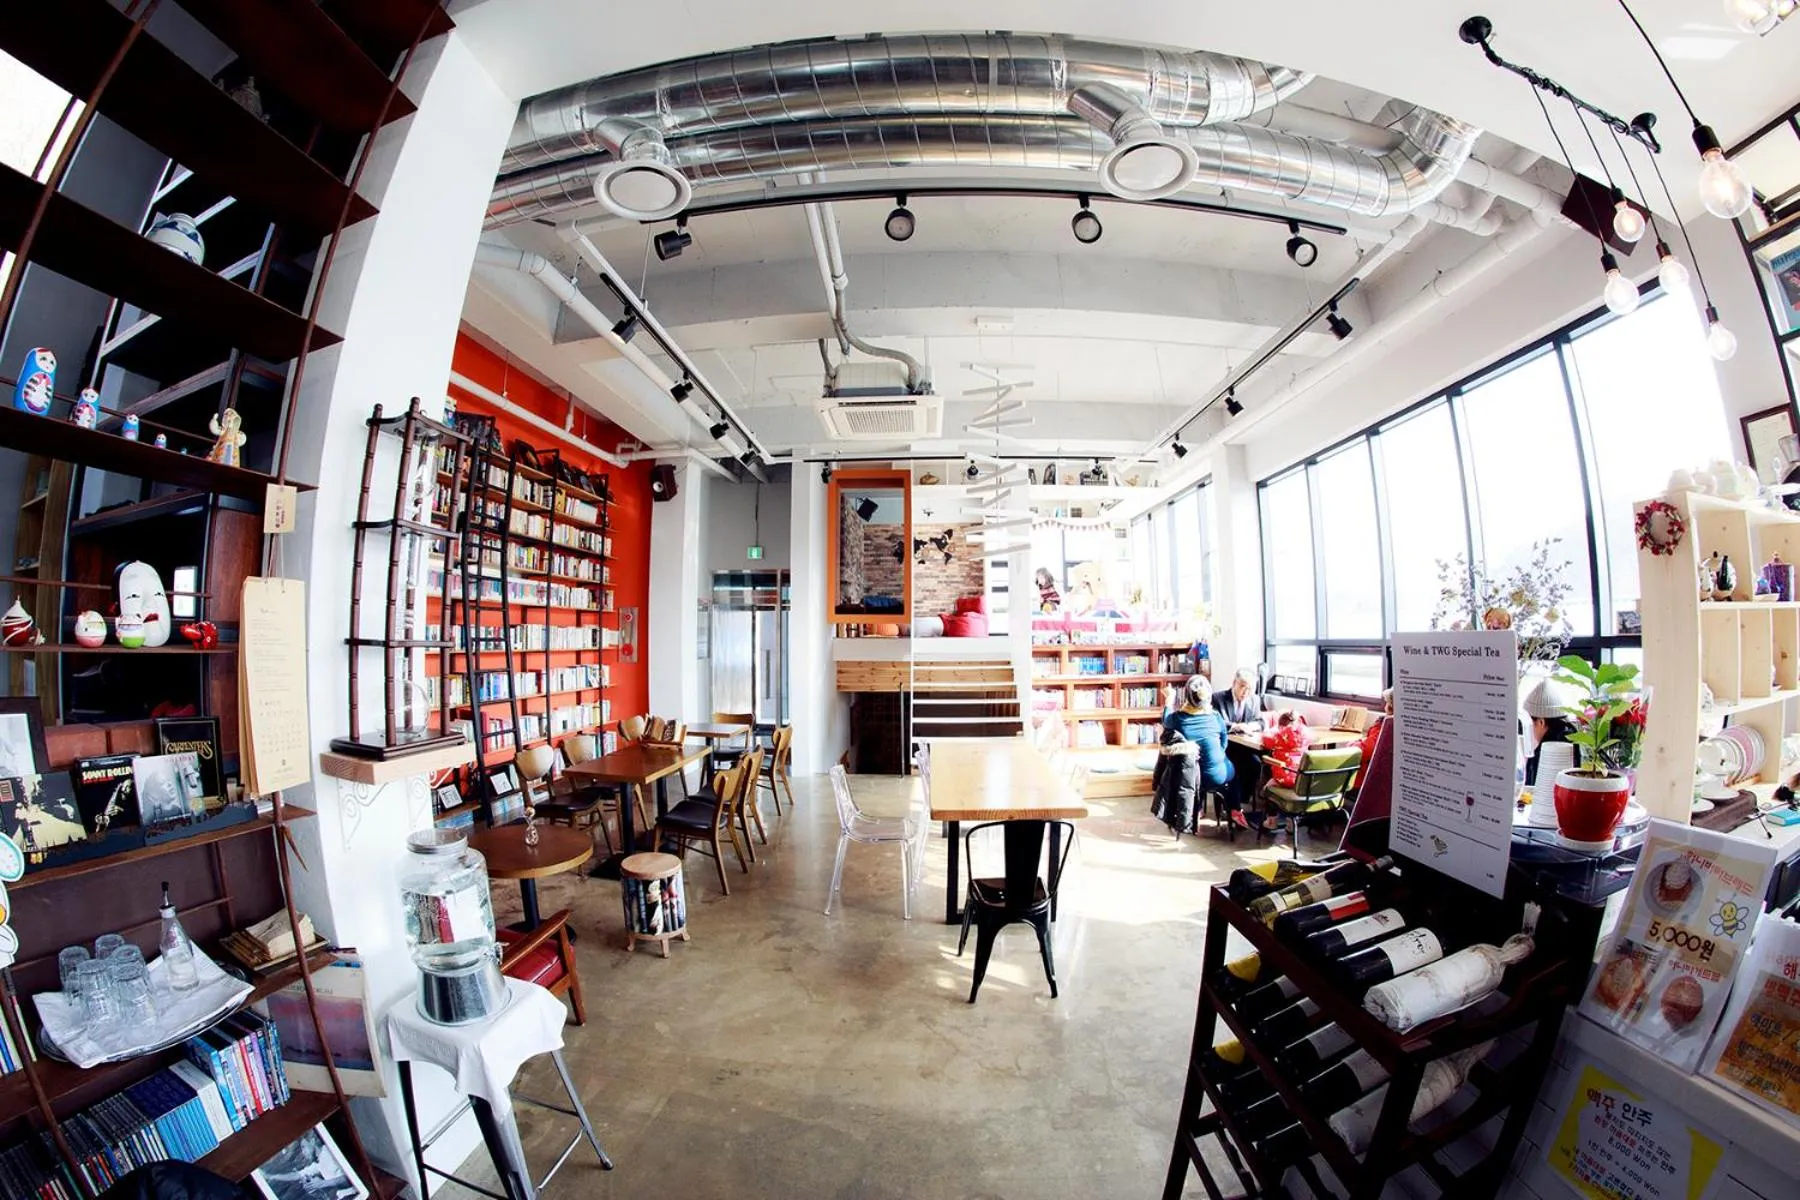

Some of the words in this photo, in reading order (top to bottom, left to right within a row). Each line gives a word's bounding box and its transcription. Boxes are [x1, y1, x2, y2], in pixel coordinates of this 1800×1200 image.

[1403, 645, 1421, 656] Wine
[1423, 646, 1430, 655] &
[1431, 646, 1450, 656] TWG
[1452, 646, 1482, 659] Special
[1484, 646, 1500, 657] Tea
[1649, 921, 1716, 961] 5,000원
[1587, 1088, 1616, 1111] 맥주
[1622, 1102, 1653, 1127] 안주
